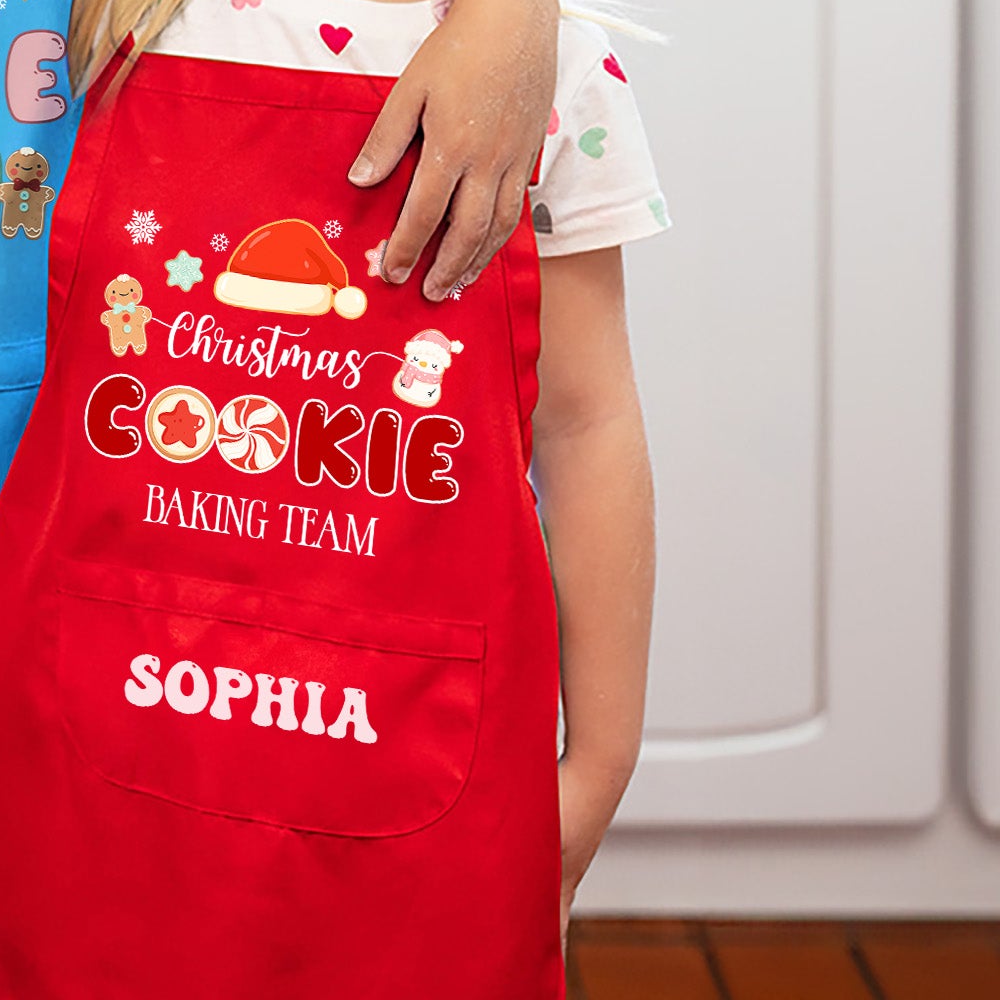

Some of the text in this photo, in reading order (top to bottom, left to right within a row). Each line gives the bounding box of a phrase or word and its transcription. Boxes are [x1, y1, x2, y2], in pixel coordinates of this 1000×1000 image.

[167, 311, 366, 390] Christmas
[84, 373, 465, 504] COOKIE
[143, 483, 380, 557] BAKING TEAM
[124, 653, 378, 744] SOPHIA
